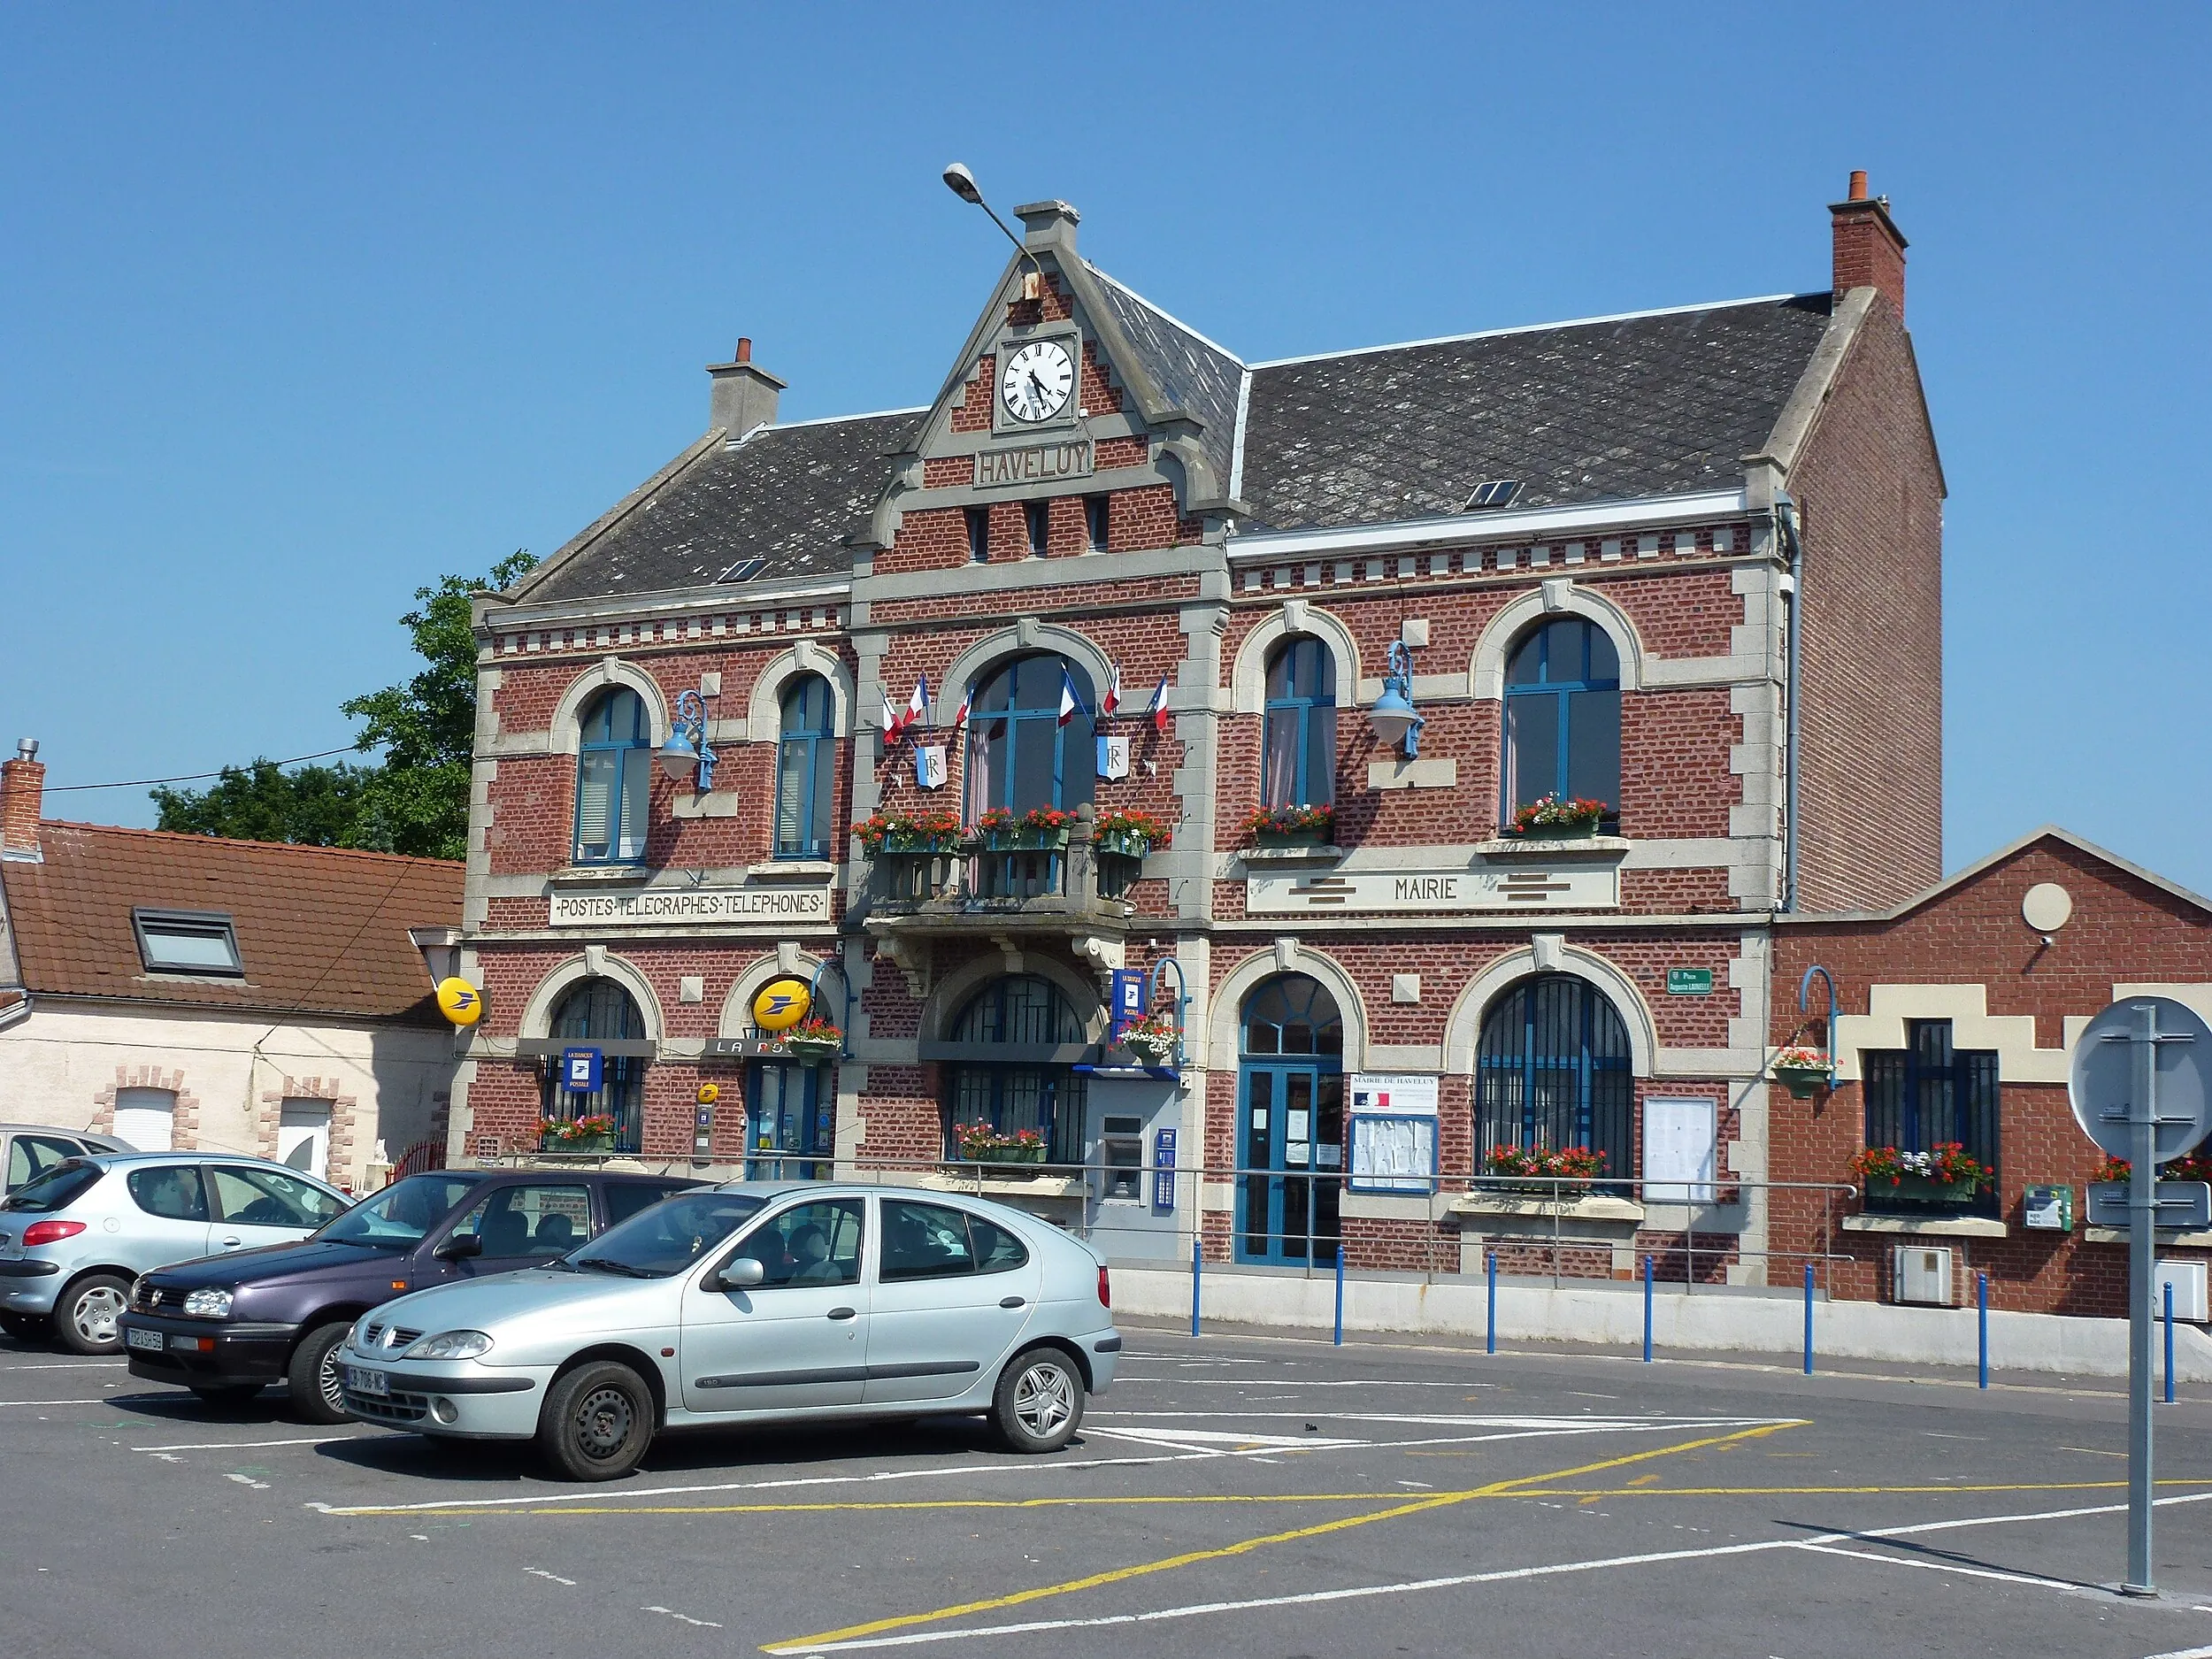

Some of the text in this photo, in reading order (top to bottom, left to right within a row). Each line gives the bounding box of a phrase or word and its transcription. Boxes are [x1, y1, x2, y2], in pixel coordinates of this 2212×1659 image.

[979, 445, 1087, 482] HAVELUY
[1395, 878, 1458, 900] MAIRIE
[717, 1041, 742, 1053] LA
